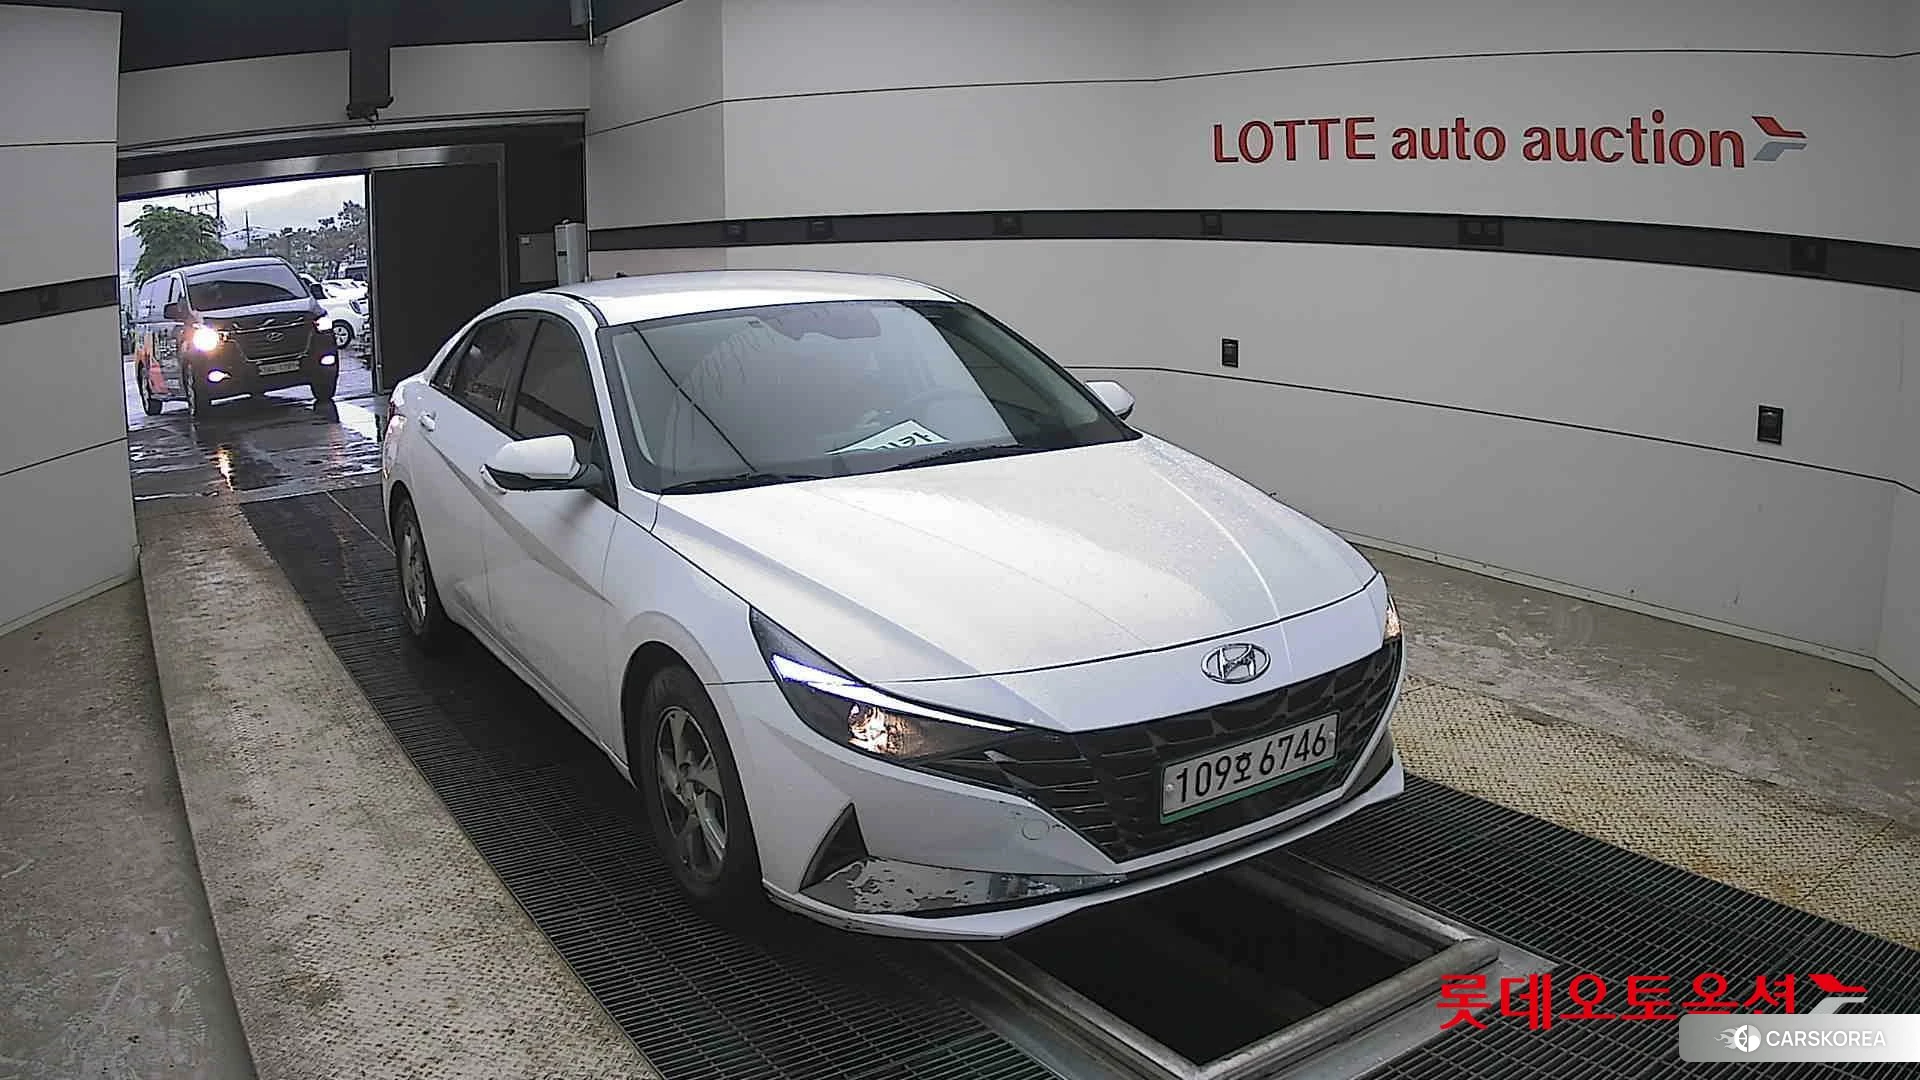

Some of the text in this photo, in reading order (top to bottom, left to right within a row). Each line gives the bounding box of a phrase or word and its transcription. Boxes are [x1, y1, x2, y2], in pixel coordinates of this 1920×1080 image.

[1213, 109, 1745, 168] LOTTE auto auction
